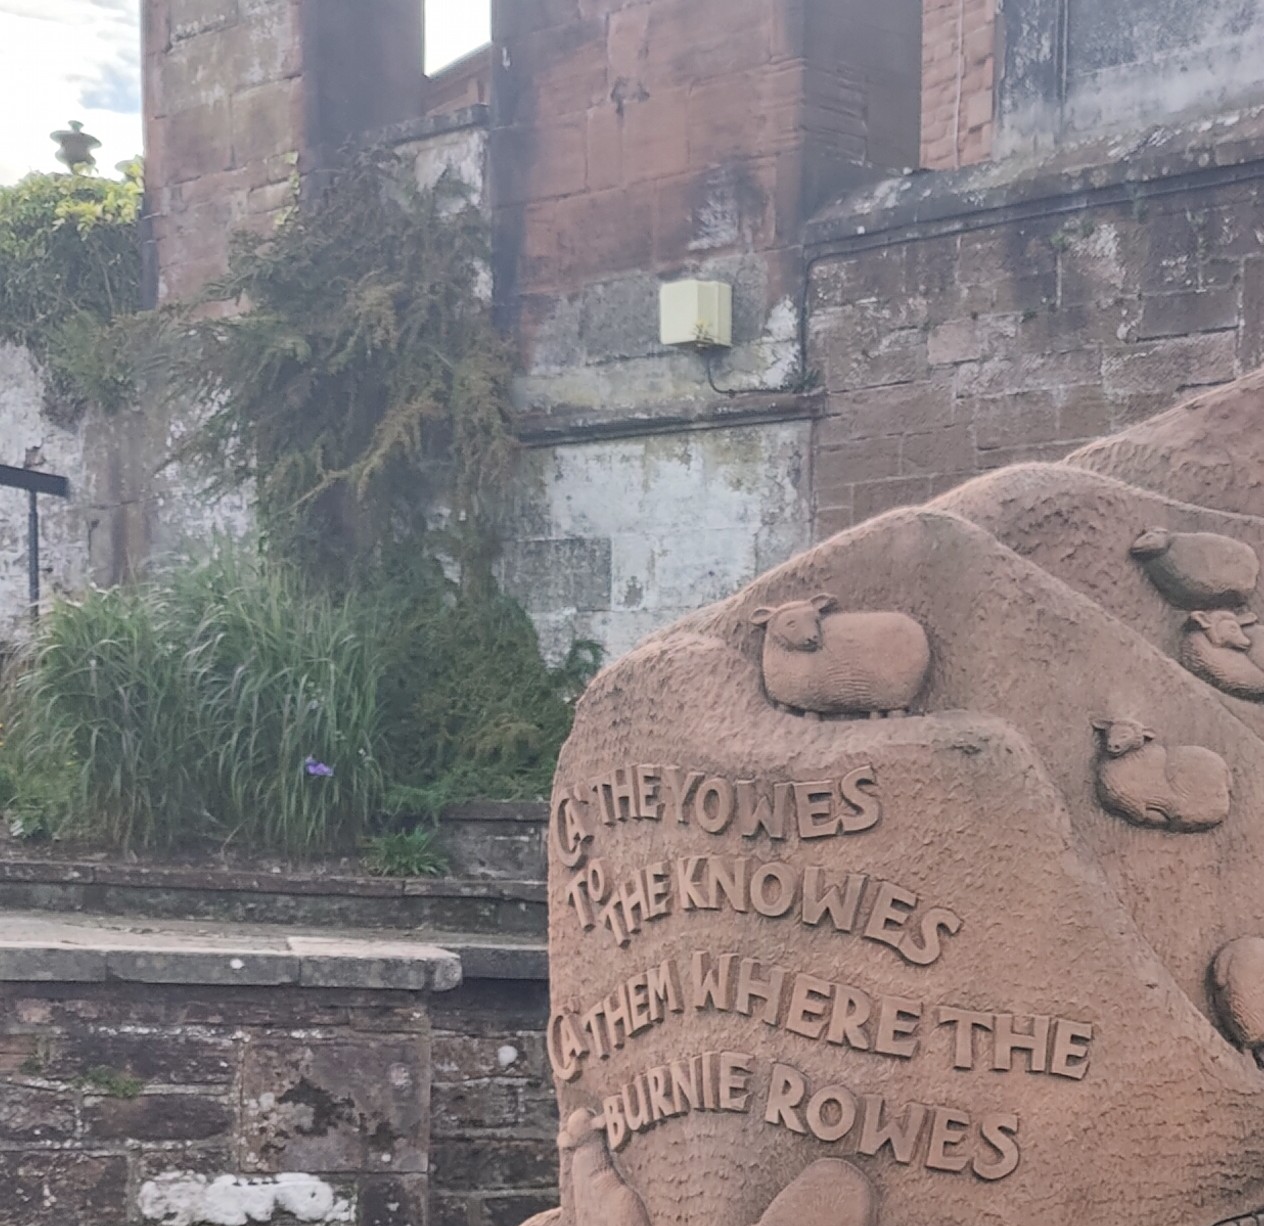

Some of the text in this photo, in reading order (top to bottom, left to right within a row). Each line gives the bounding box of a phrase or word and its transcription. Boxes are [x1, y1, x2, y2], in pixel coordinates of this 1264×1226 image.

[588, 763, 664, 826] THE
[662, 765, 882, 840] YOWES
[565, 856, 963, 966] TO THE KNOWES
[582, 959, 684, 1060] THEM
[693, 951, 923, 1058] WHERE
[938, 1007, 1094, 1080] THE
[603, 1051, 1021, 1182] BURNIE ROWES
